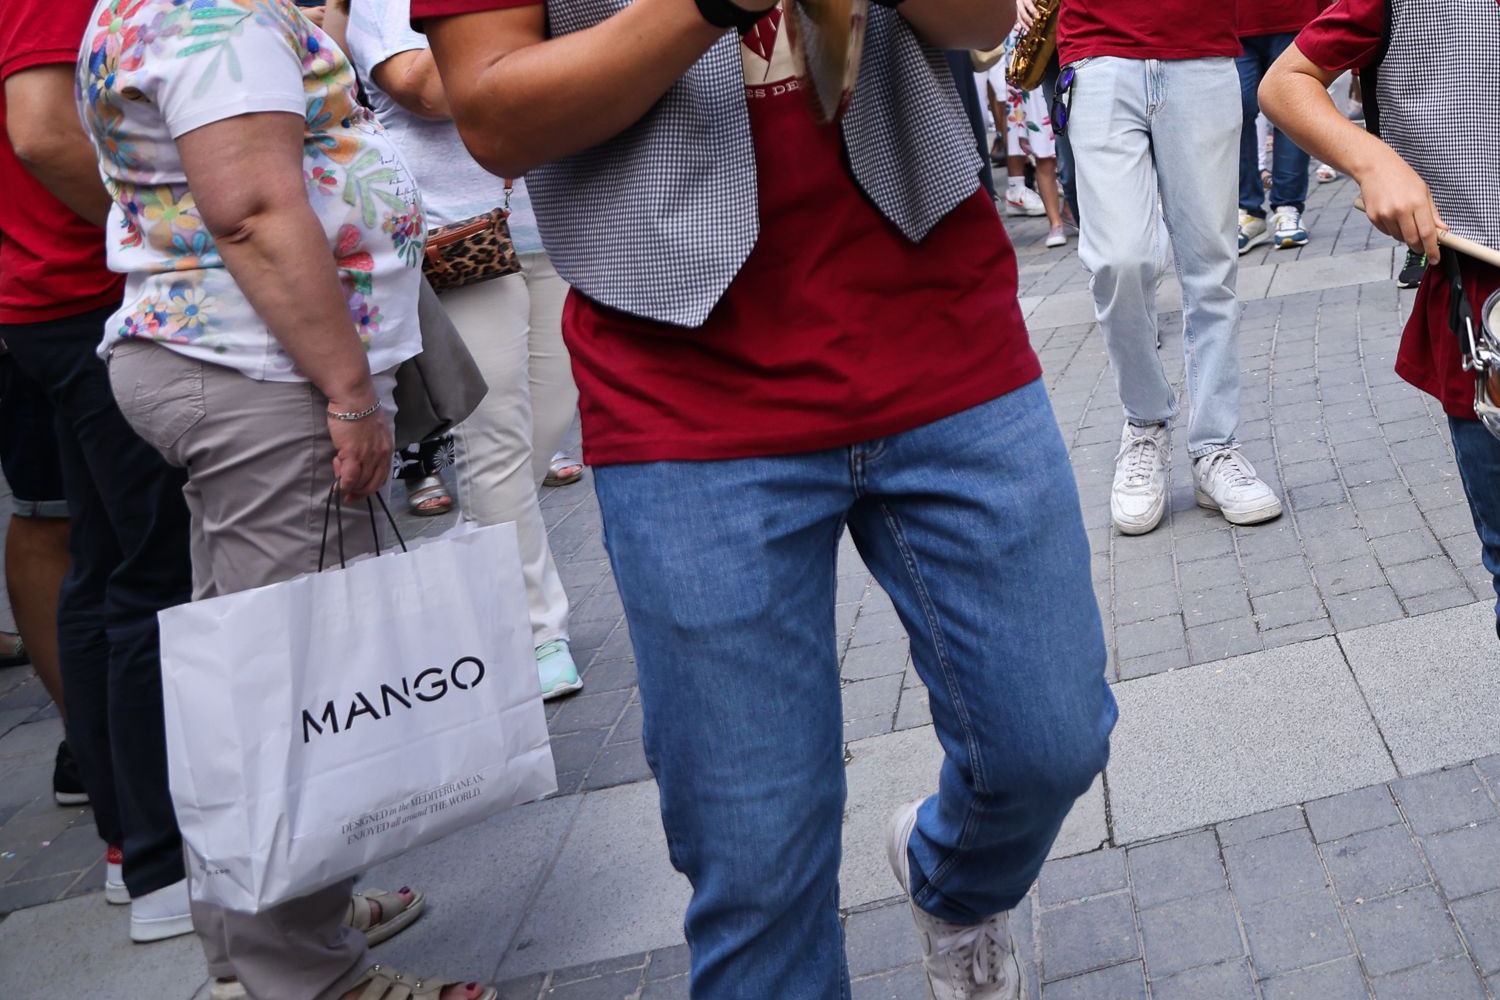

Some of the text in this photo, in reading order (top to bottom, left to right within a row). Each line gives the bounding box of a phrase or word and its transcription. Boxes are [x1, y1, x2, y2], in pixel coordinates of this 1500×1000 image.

[302, 656, 486, 744] MANGO
[341, 808, 389, 835] DESIGNED
[347, 821, 390, 845] ENJOYED
[402, 807, 428, 824] around
[428, 801, 448, 814] THE
